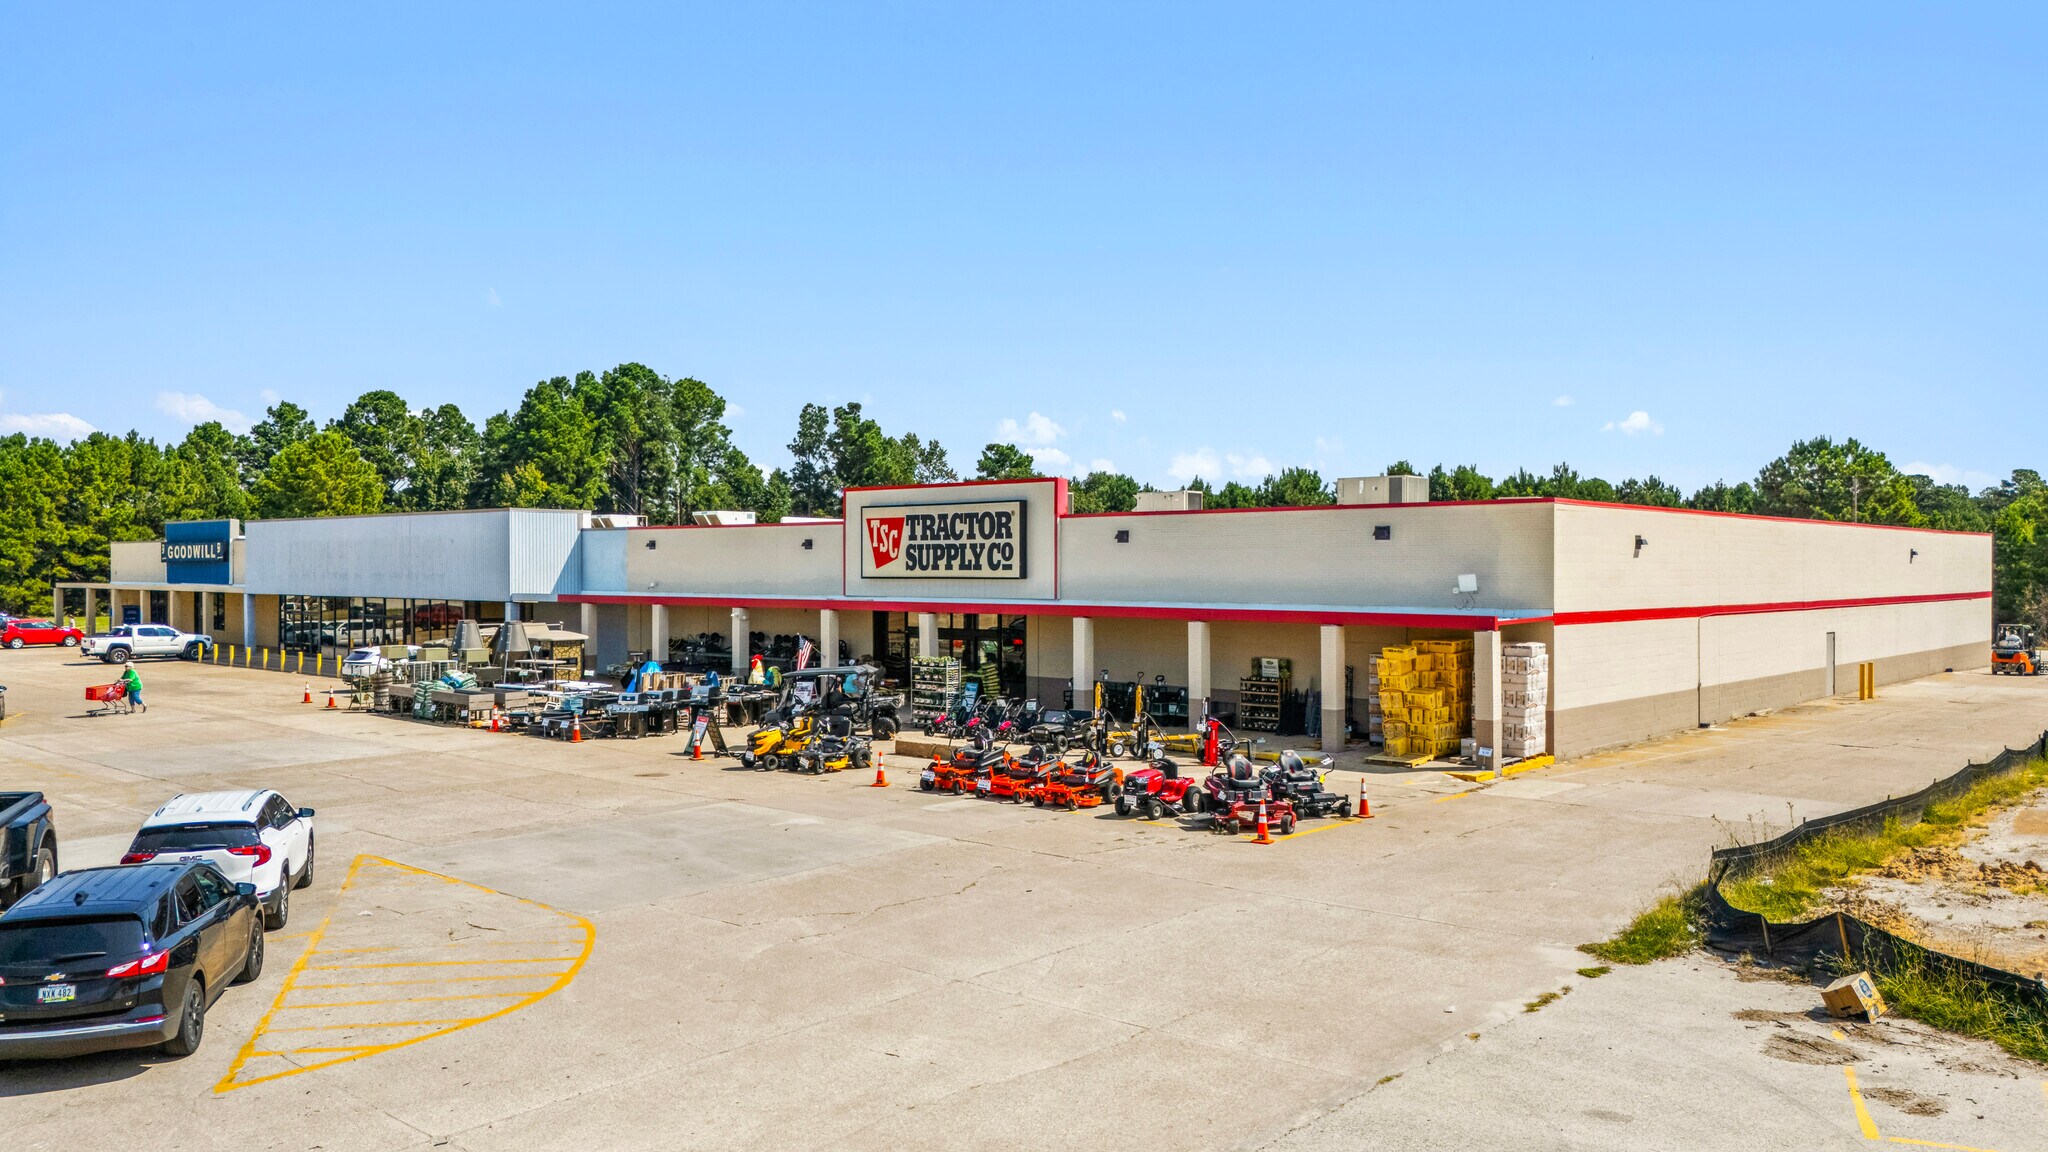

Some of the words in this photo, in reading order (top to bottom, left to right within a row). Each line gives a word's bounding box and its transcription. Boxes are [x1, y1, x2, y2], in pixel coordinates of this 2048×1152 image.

[870, 519, 899, 559] TSC
[905, 511, 1013, 541] TRACTOR
[167, 544, 216, 559] GOODWILL
[905, 543, 986, 571] SUPPLY
[57, 988, 72, 997] 482
